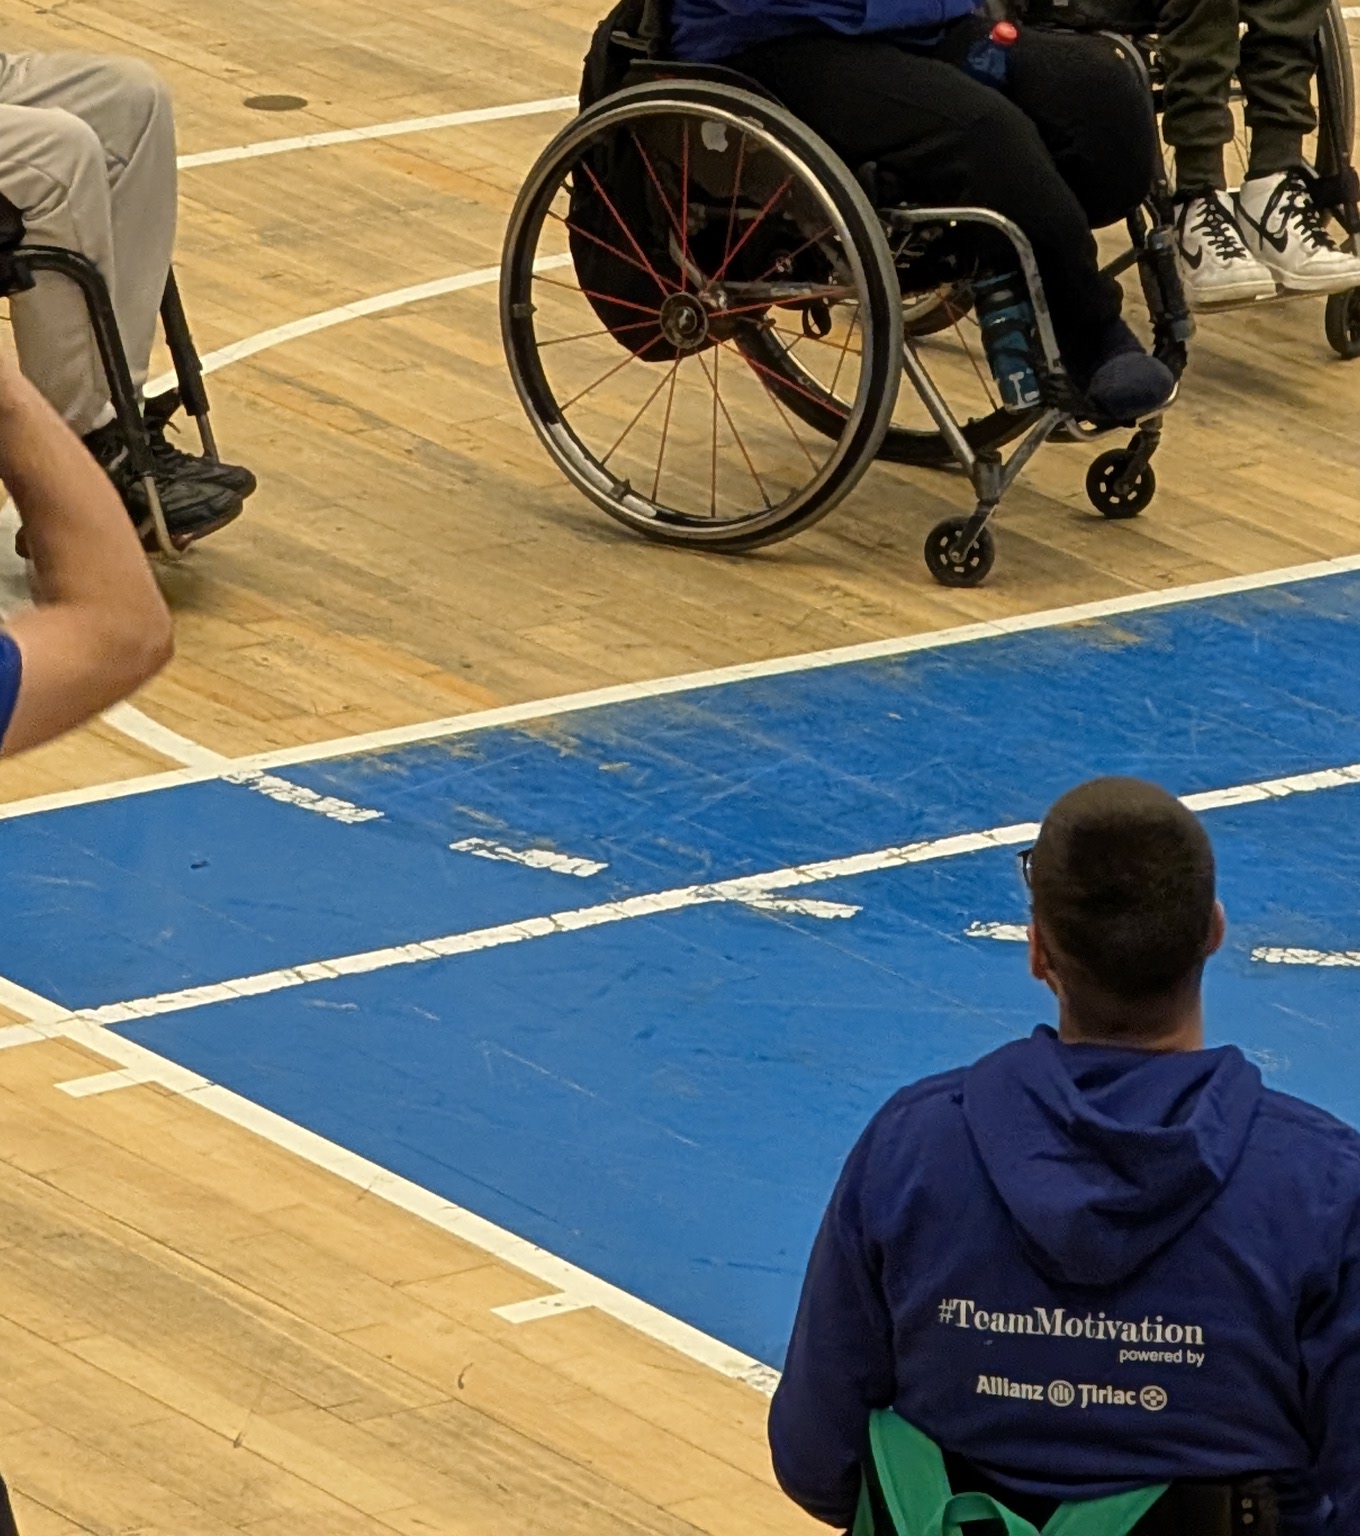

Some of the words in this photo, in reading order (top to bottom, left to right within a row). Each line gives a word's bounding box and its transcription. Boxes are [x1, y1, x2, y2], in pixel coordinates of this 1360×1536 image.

[938, 1298, 1205, 1345] #TeamMotivation
[1119, 1349, 1183, 1364] powered
[1186, 1349, 1205, 1368] by
[976, 1375, 1044, 1401] Allianz
